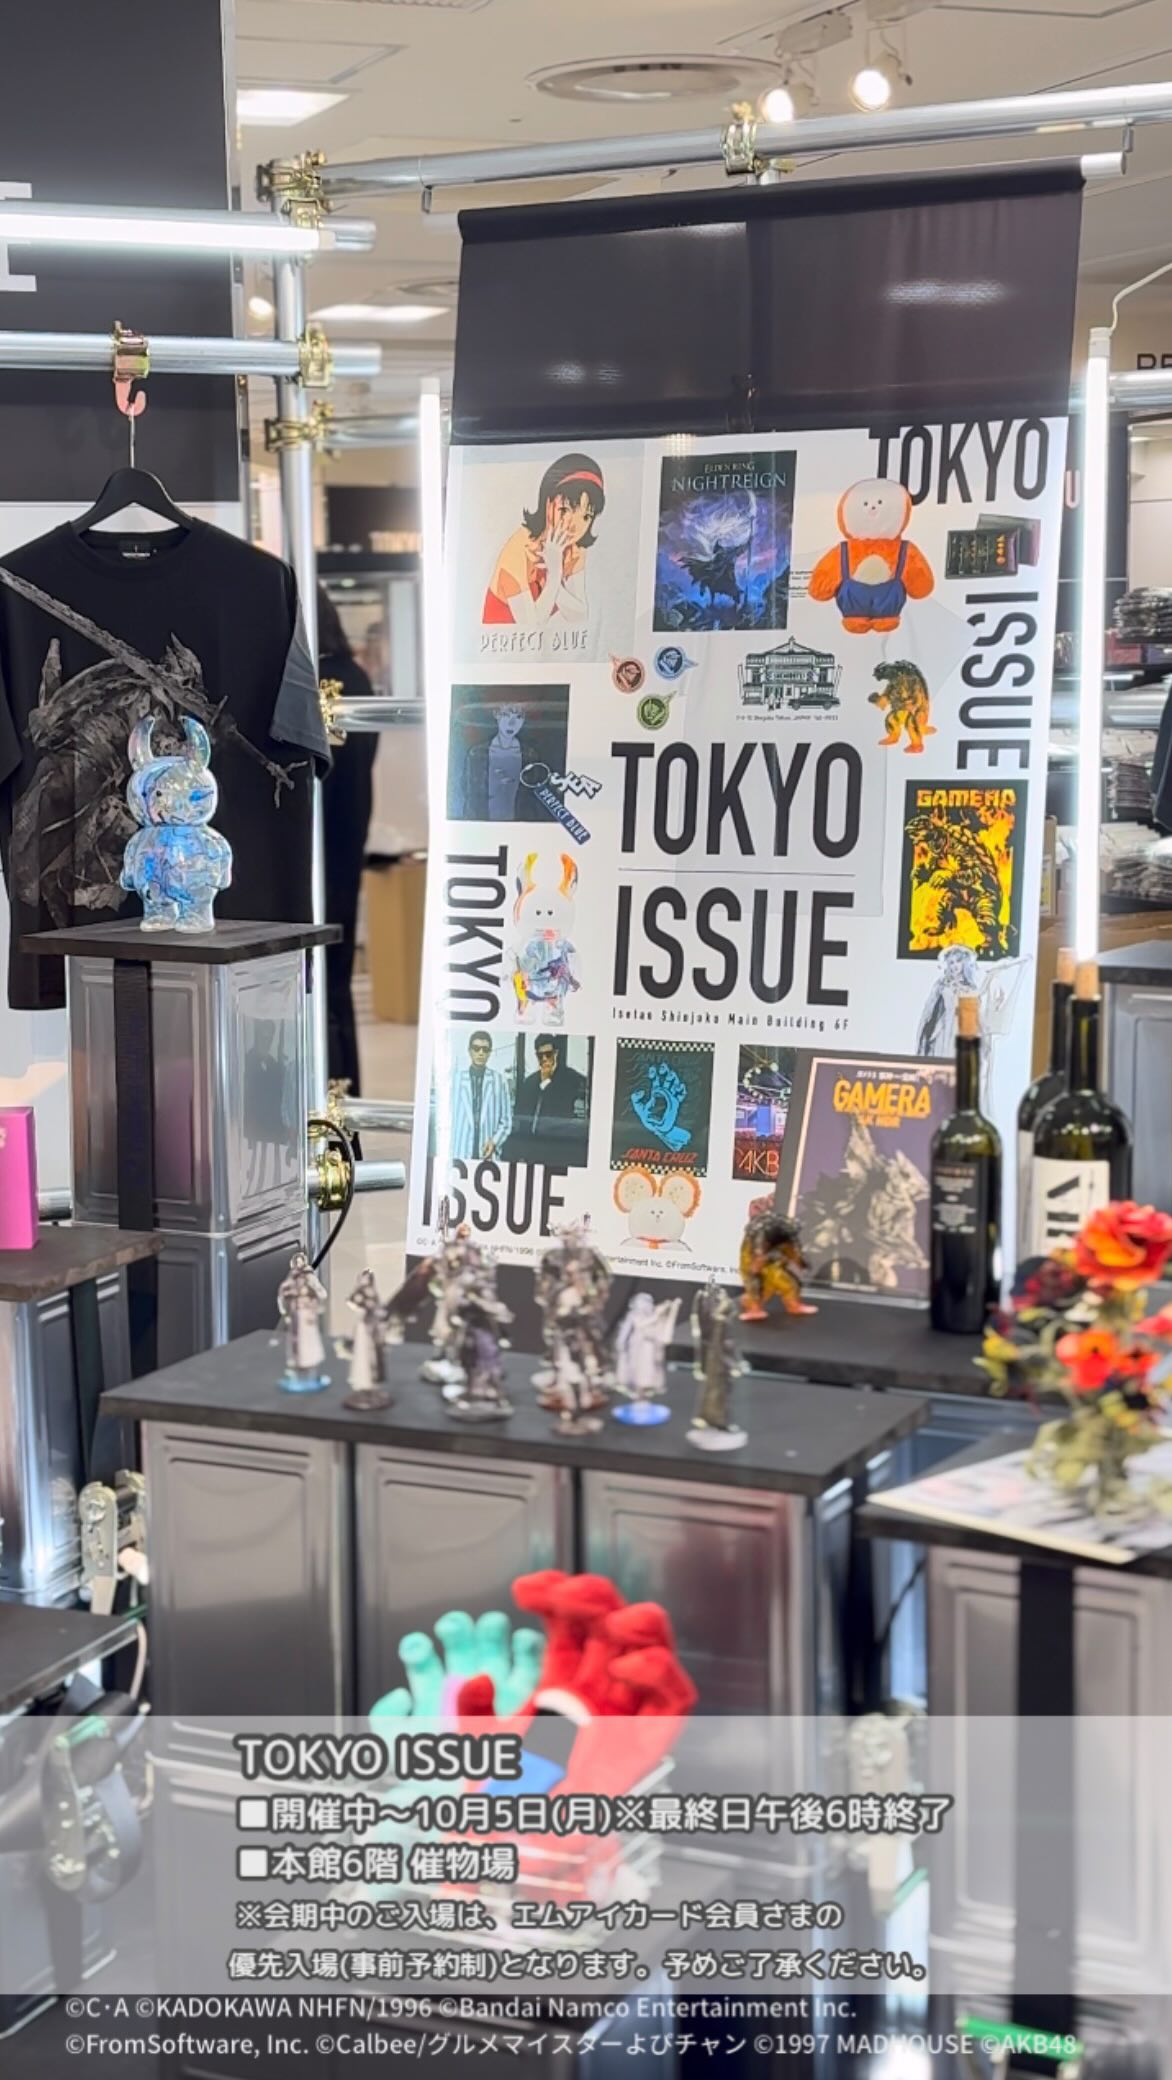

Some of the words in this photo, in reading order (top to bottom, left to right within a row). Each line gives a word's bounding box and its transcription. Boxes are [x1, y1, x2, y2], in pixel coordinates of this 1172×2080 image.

[671, 472, 786, 492] NIGHTREIGN
[869, 417, 1049, 505] TOKYO
[480, 632, 544, 653] PERFECT
[552, 630, 588, 651] BLUE
[957, 592, 1039, 769] ISSUE
[611, 741, 863, 858] TOKYO
[444, 845, 508, 1022] TOKYO
[613, 885, 854, 1006] ISSUE
[728, 1013, 758, 1025] Main
[767, 1015, 824, 1031] Building
[834, 1078, 932, 1119] GAMERA
[423, 1157, 568, 1236] ISSUE
